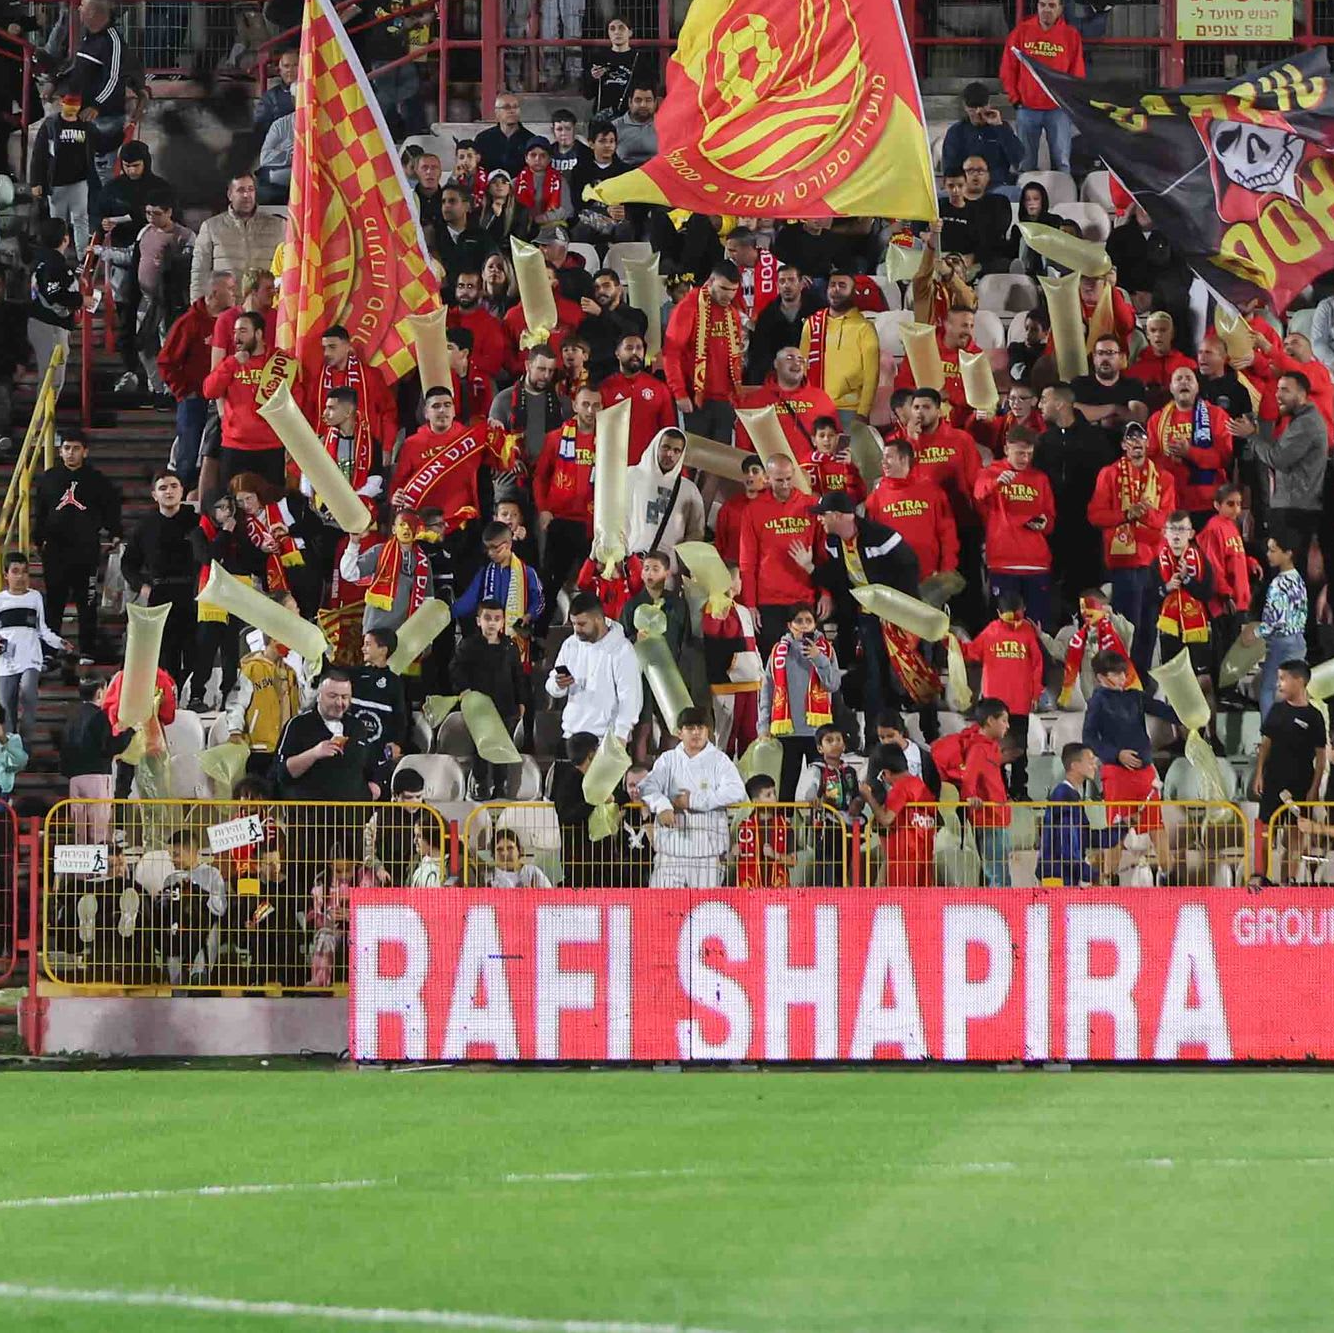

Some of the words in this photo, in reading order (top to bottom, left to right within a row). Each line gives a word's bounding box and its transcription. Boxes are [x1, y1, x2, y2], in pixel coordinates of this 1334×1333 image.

[1196, 24, 1238, 37] צופים
[852, 74, 887, 148] מועדון
[795, 147, 851, 199] ספורט
[723, 189, 786, 209] אשדוד
[363, 216, 390, 289] מועדון
[350, 296, 385, 345] ספור
[883, 499, 929, 514] ULTRAS
[892, 509, 923, 519] ASHDOD
[765, 516, 812, 530] ULTRAS
[775, 527, 805, 535] ASHDOD
[352, 902, 632, 1061] RAFI
[676, 899, 1233, 1061] SHAPIRA
